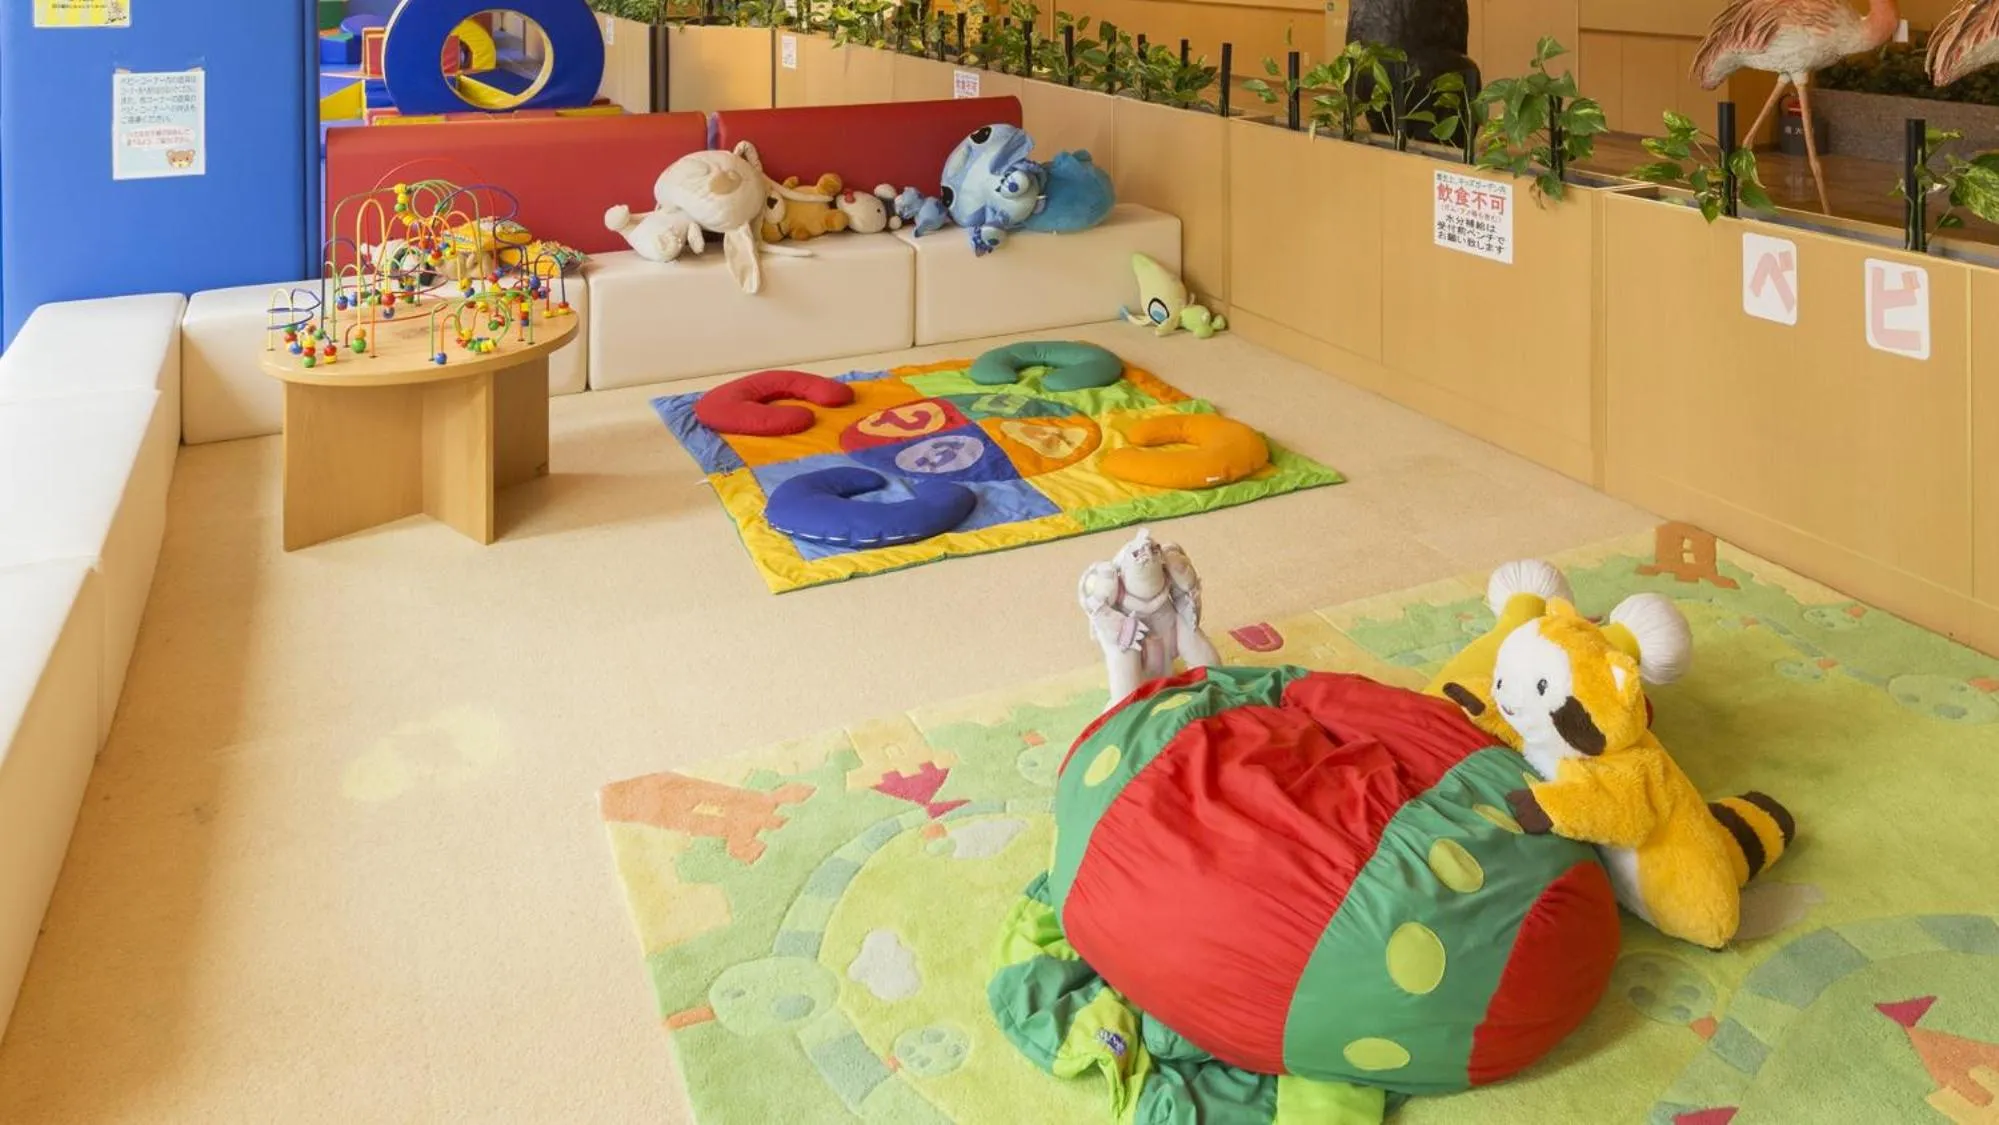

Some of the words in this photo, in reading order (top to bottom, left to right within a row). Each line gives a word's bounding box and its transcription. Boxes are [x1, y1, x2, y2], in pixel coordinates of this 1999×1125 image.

[1437, 182, 1506, 215] 飲食不可
[1437, 221, 1505, 246] 受付前ベンチで
[1445, 214, 1495, 233] 水分補給は
[1438, 231, 1504, 254] お願い致します
[1749, 250, 1795, 314] ベ
[1872, 266, 1921, 352] ビ
